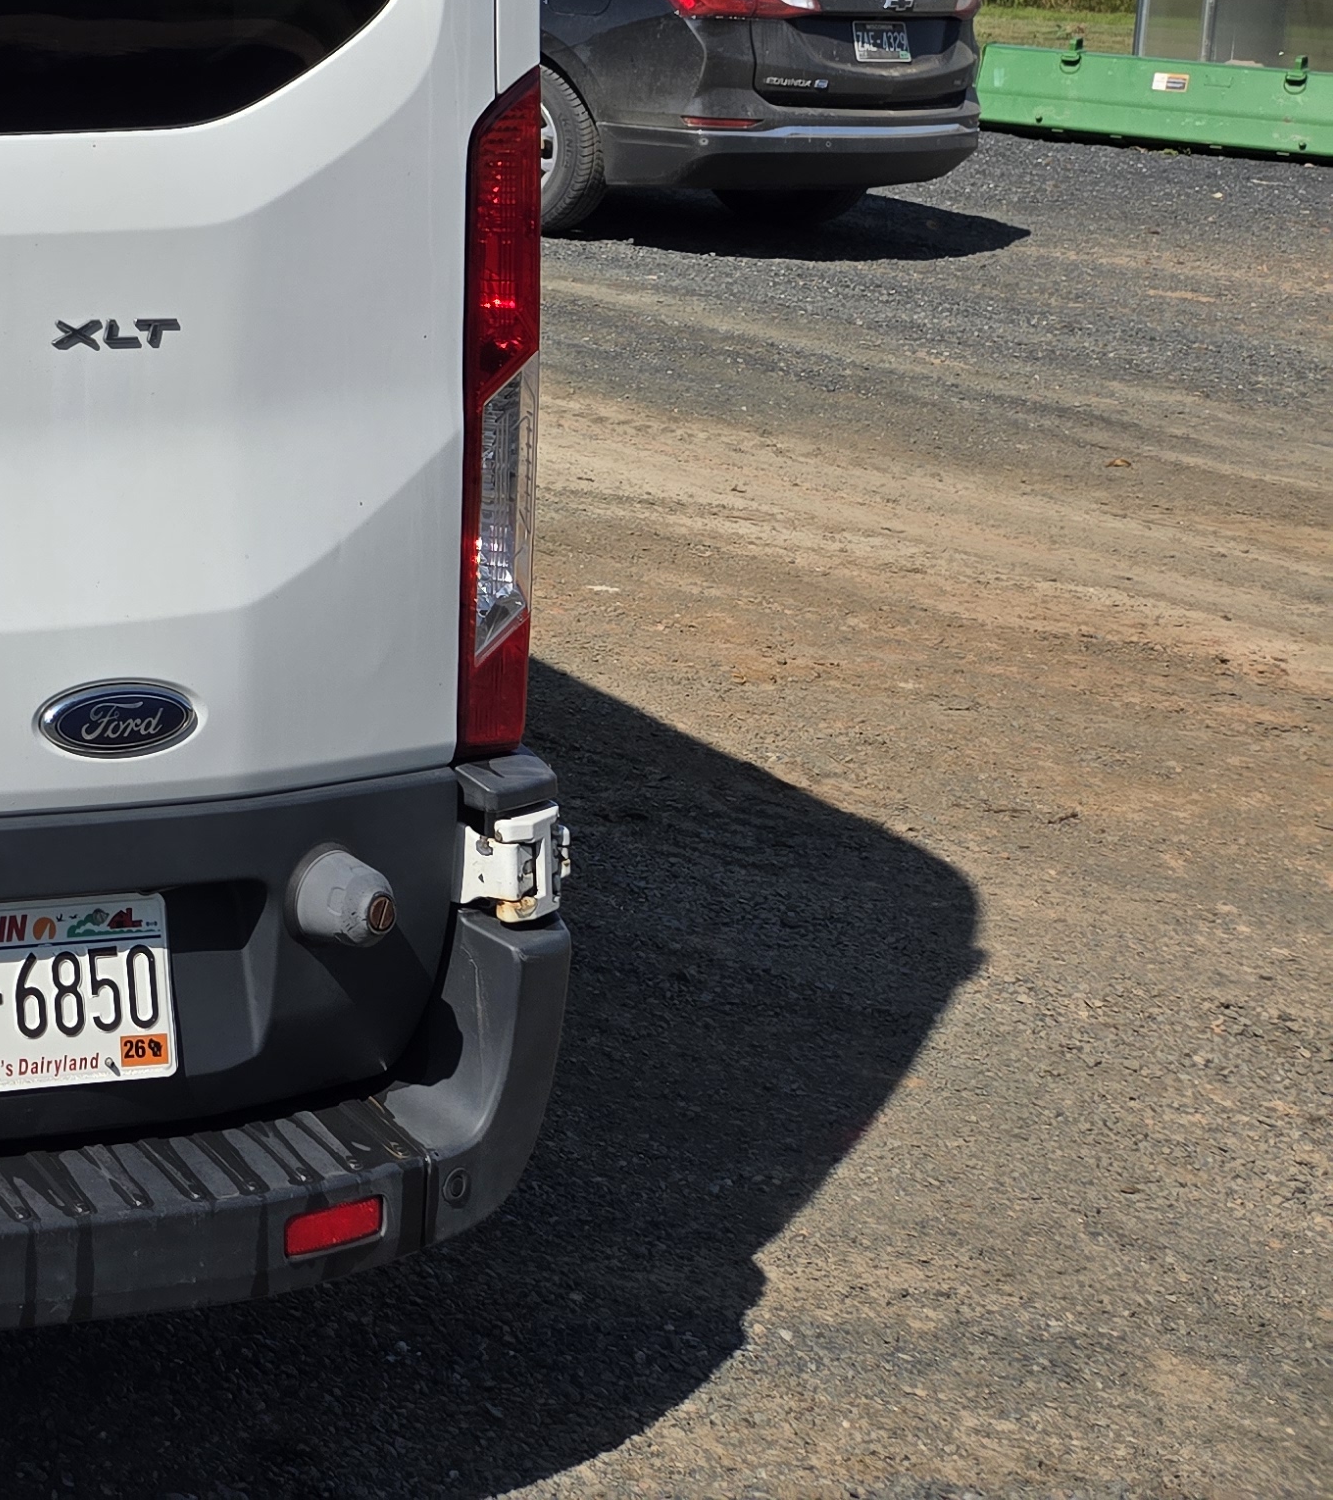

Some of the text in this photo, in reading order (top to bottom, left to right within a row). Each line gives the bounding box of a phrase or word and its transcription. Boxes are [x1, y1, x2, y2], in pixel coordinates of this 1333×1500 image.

[51, 318, 181, 351] XLT
[81, 701, 164, 740] Ford
[123, 1038, 147, 1059] 26
[18, 1052, 100, 1077] Dairyland
